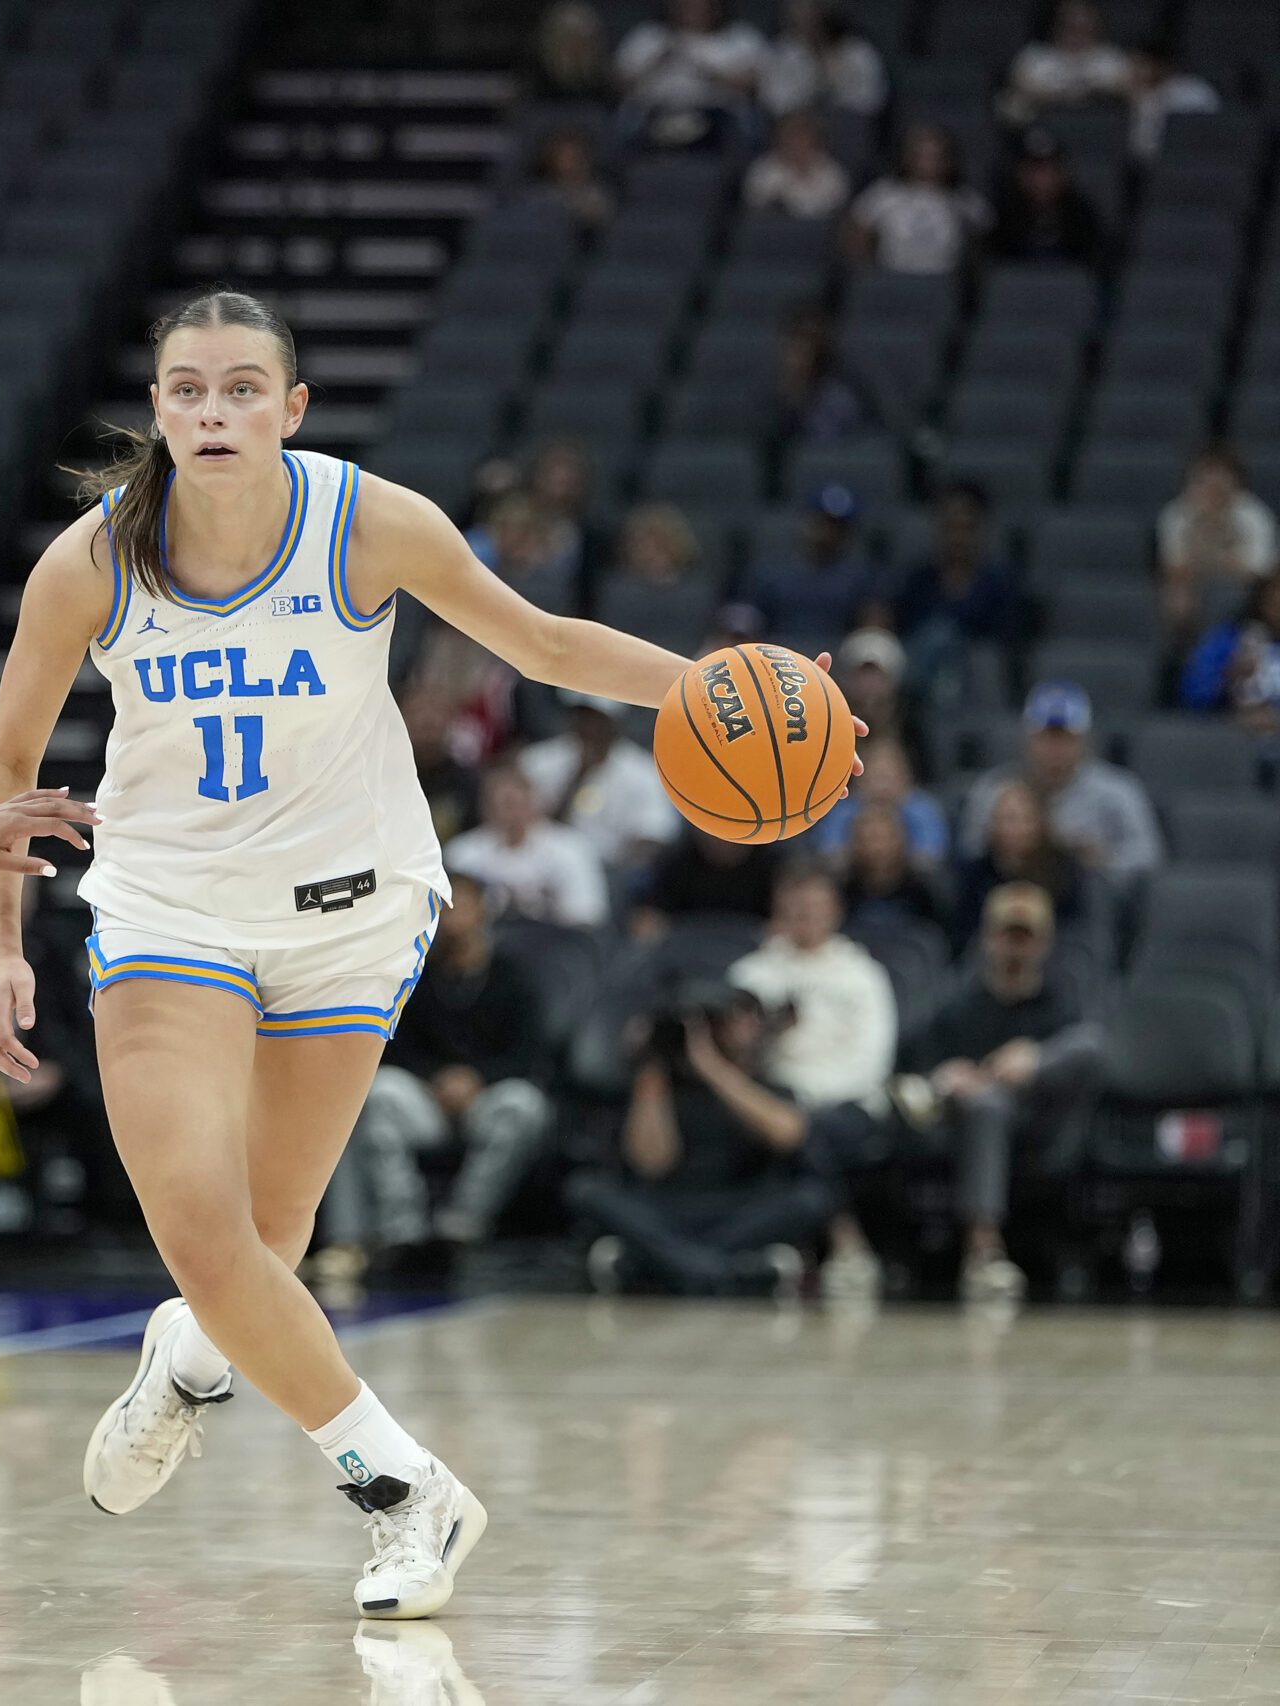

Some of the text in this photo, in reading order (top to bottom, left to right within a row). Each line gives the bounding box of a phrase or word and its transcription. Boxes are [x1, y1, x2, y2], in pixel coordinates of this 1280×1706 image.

[134, 647, 326, 703] UCLA
[700, 660, 754, 743] NCAA
[755, 645, 808, 744] Wilson
[192, 715, 269, 802] 11
[356, 878, 371, 891] 44
